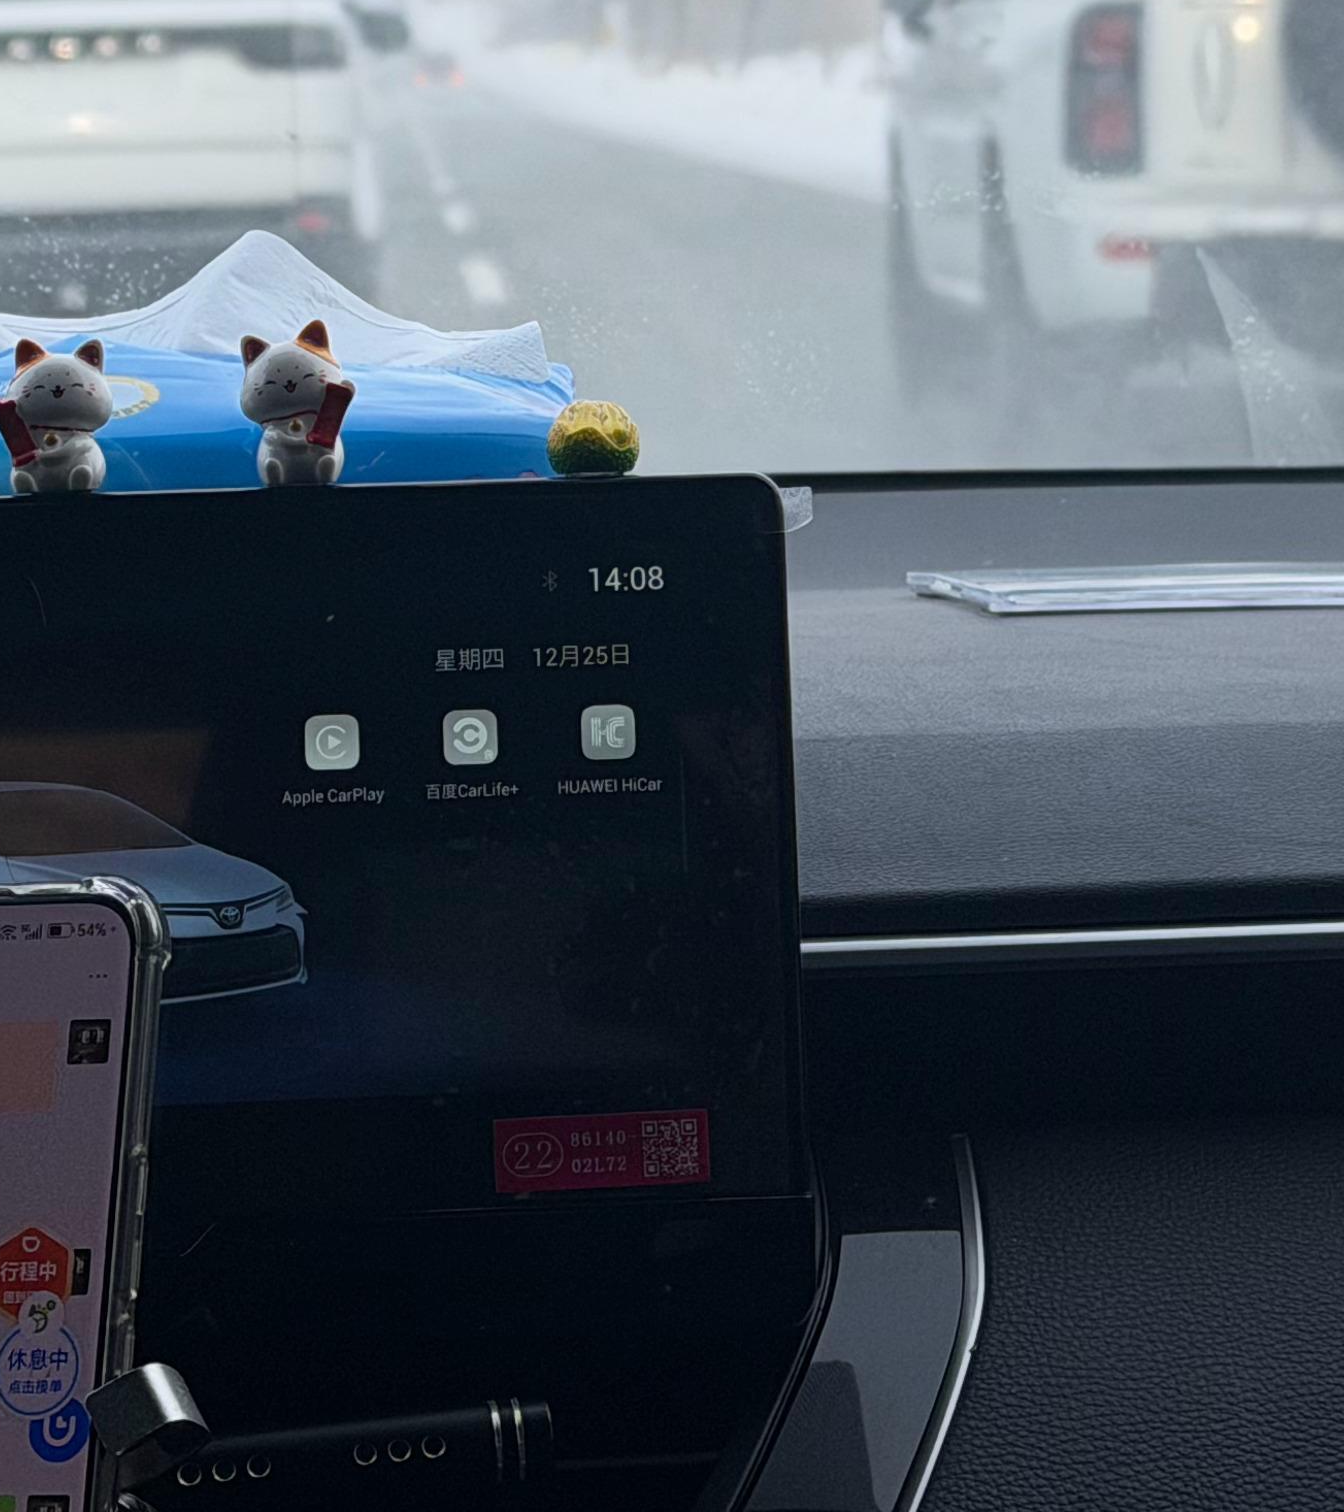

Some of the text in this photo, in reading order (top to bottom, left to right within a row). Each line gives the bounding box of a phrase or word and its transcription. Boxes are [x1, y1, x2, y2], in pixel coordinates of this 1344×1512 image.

[588, 565, 665, 592] 14:08
[435, 643, 631, 672] 星期四 12月25日
[282, 786, 385, 807] Apple CarPlay
[425, 780, 519, 801] 百度CarLife+
[557, 776, 663, 795] HUAWEI HiCar
[77, 922, 107, 939] 54%
[514, 1140, 553, 1170] 22
[572, 1155, 627, 1174] 02L72
[0, 1260, 57, 1285] 行程中
[8, 1347, 69, 1372] 休息中
